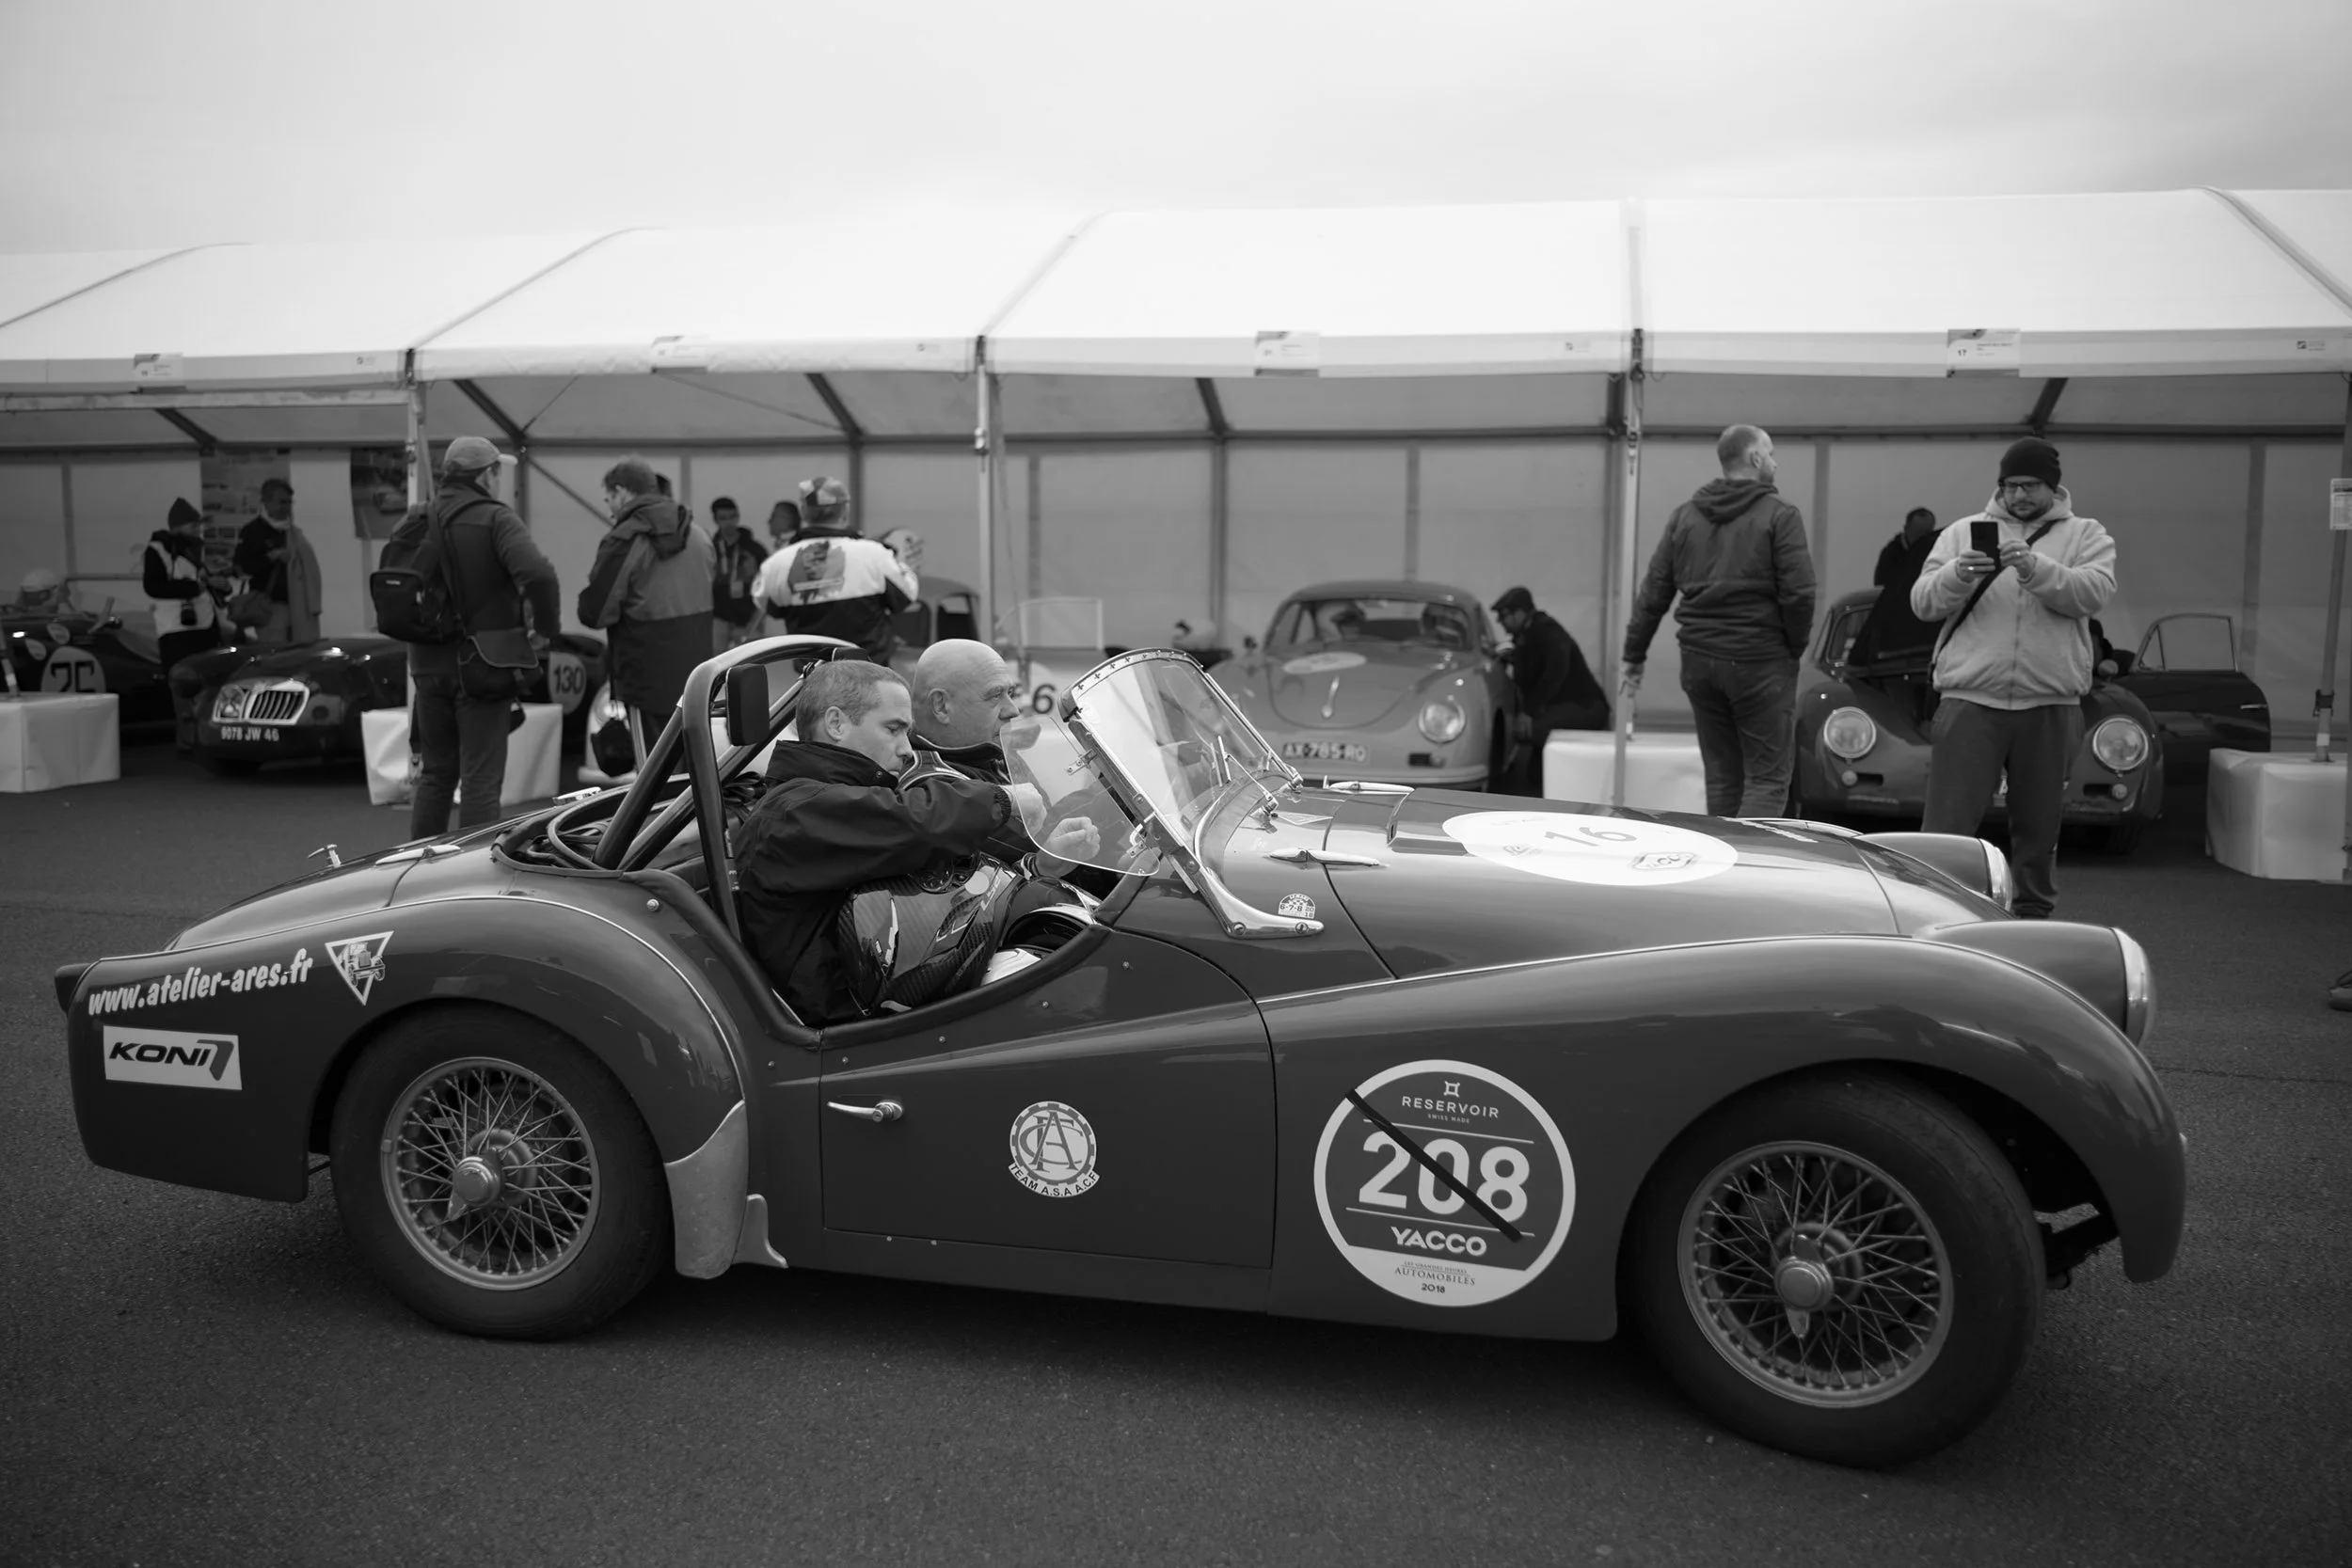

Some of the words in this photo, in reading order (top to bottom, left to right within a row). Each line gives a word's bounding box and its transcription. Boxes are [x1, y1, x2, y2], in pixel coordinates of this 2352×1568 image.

[553, 664, 584, 694] 130
[245, 726, 262, 742] JW
[263, 727, 279, 742] 46
[1544, 826, 1638, 847] 16
[87, 948, 313, 1016] www.atelier-ares.fr
[108, 1041, 213, 1067] KONI
[1402, 1096, 1500, 1118] RESERVOIR
[1451, 1116, 1470, 1124] MADE
[1009, 1164, 1039, 1191] TEAM
[1359, 1130, 1531, 1223] 208
[1390, 1225, 1487, 1257] YACCO
[1394, 1266, 1476, 1286] AUTOMOBILES
[1421, 1282, 1446, 1294] 2018
